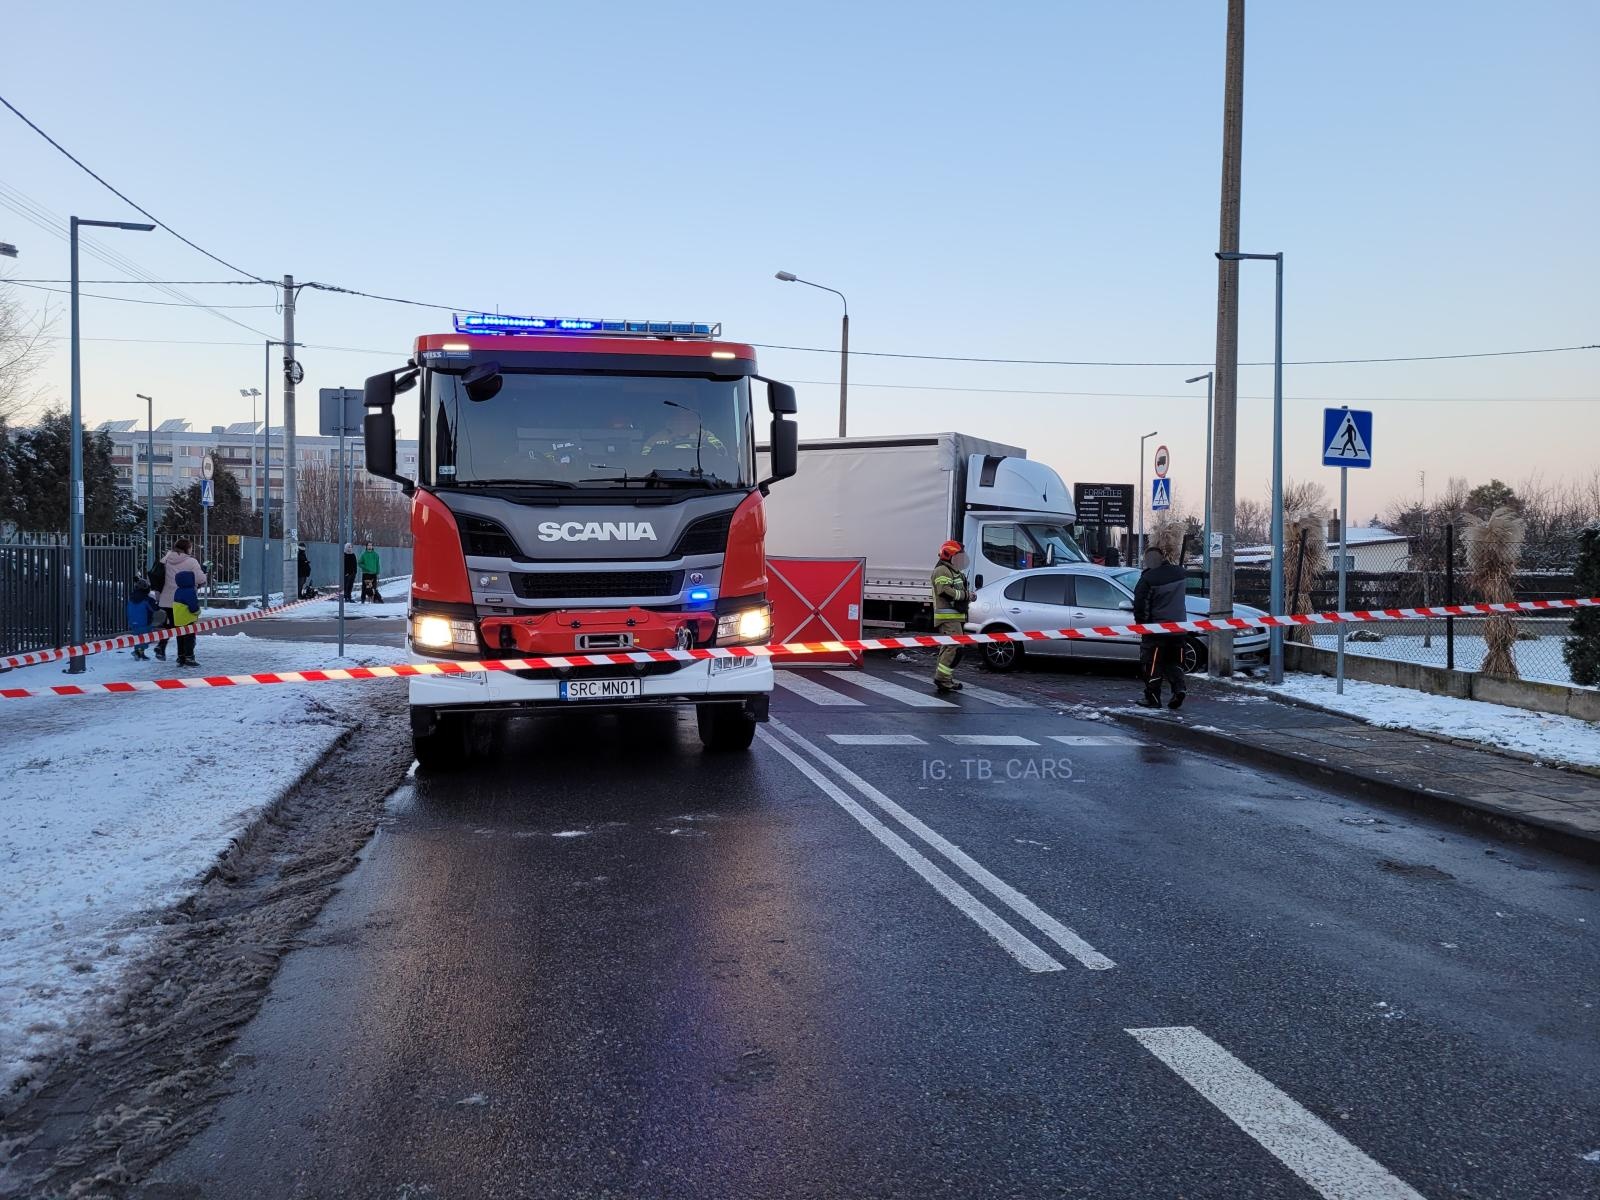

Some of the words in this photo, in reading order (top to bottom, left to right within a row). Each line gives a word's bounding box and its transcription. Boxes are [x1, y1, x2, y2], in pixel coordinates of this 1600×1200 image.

[537, 521, 658, 541] SCANIA
[570, 682, 597, 696] SRC
[602, 680, 635, 695] MN01
